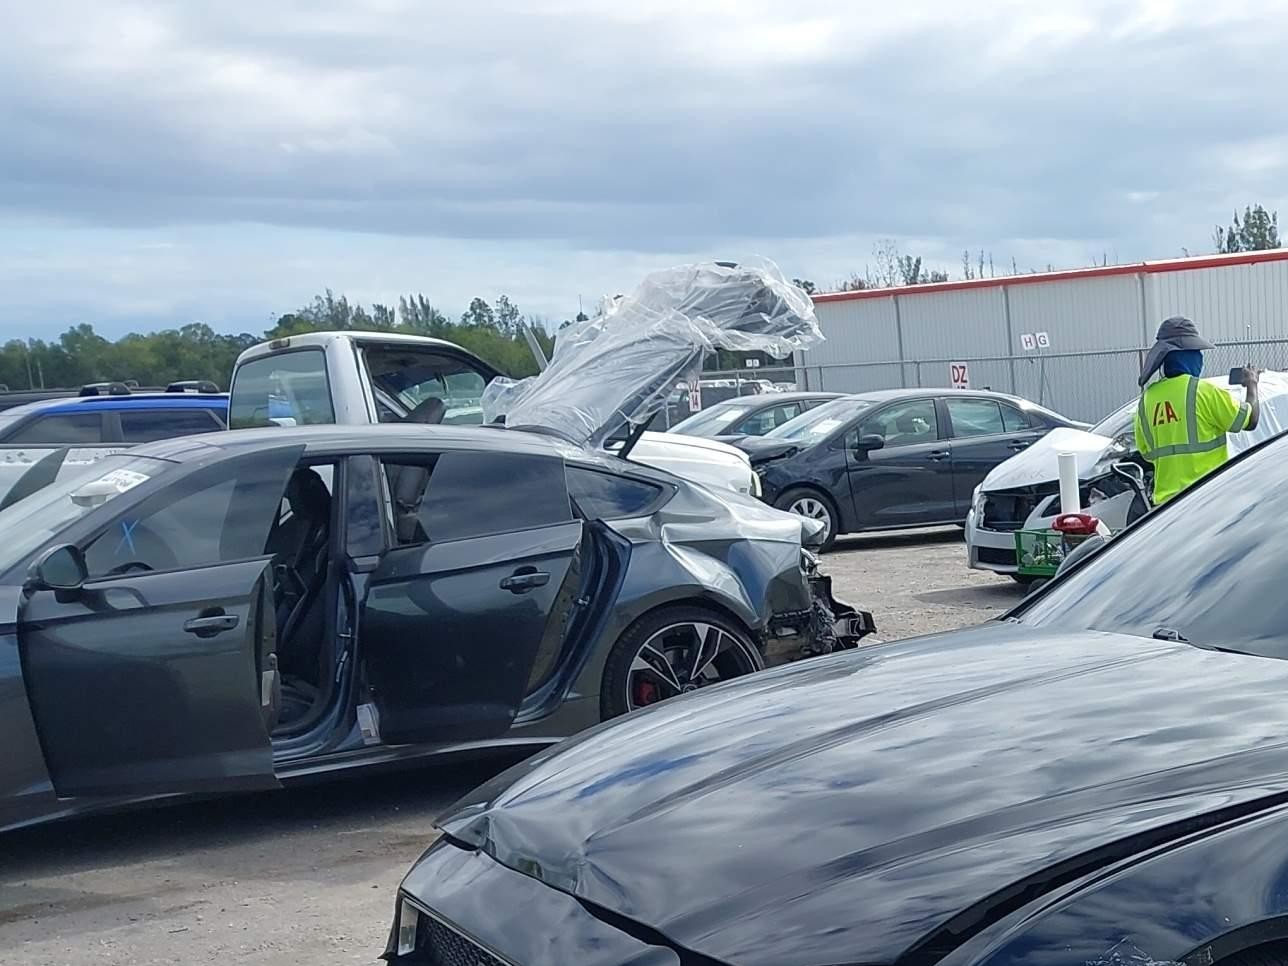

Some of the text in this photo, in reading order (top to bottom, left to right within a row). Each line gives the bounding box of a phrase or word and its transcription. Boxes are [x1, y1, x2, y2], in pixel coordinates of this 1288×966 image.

[1024, 336, 1033, 348] H
[1038, 335, 1047, 346] G
[951, 365, 968, 383] DZ
